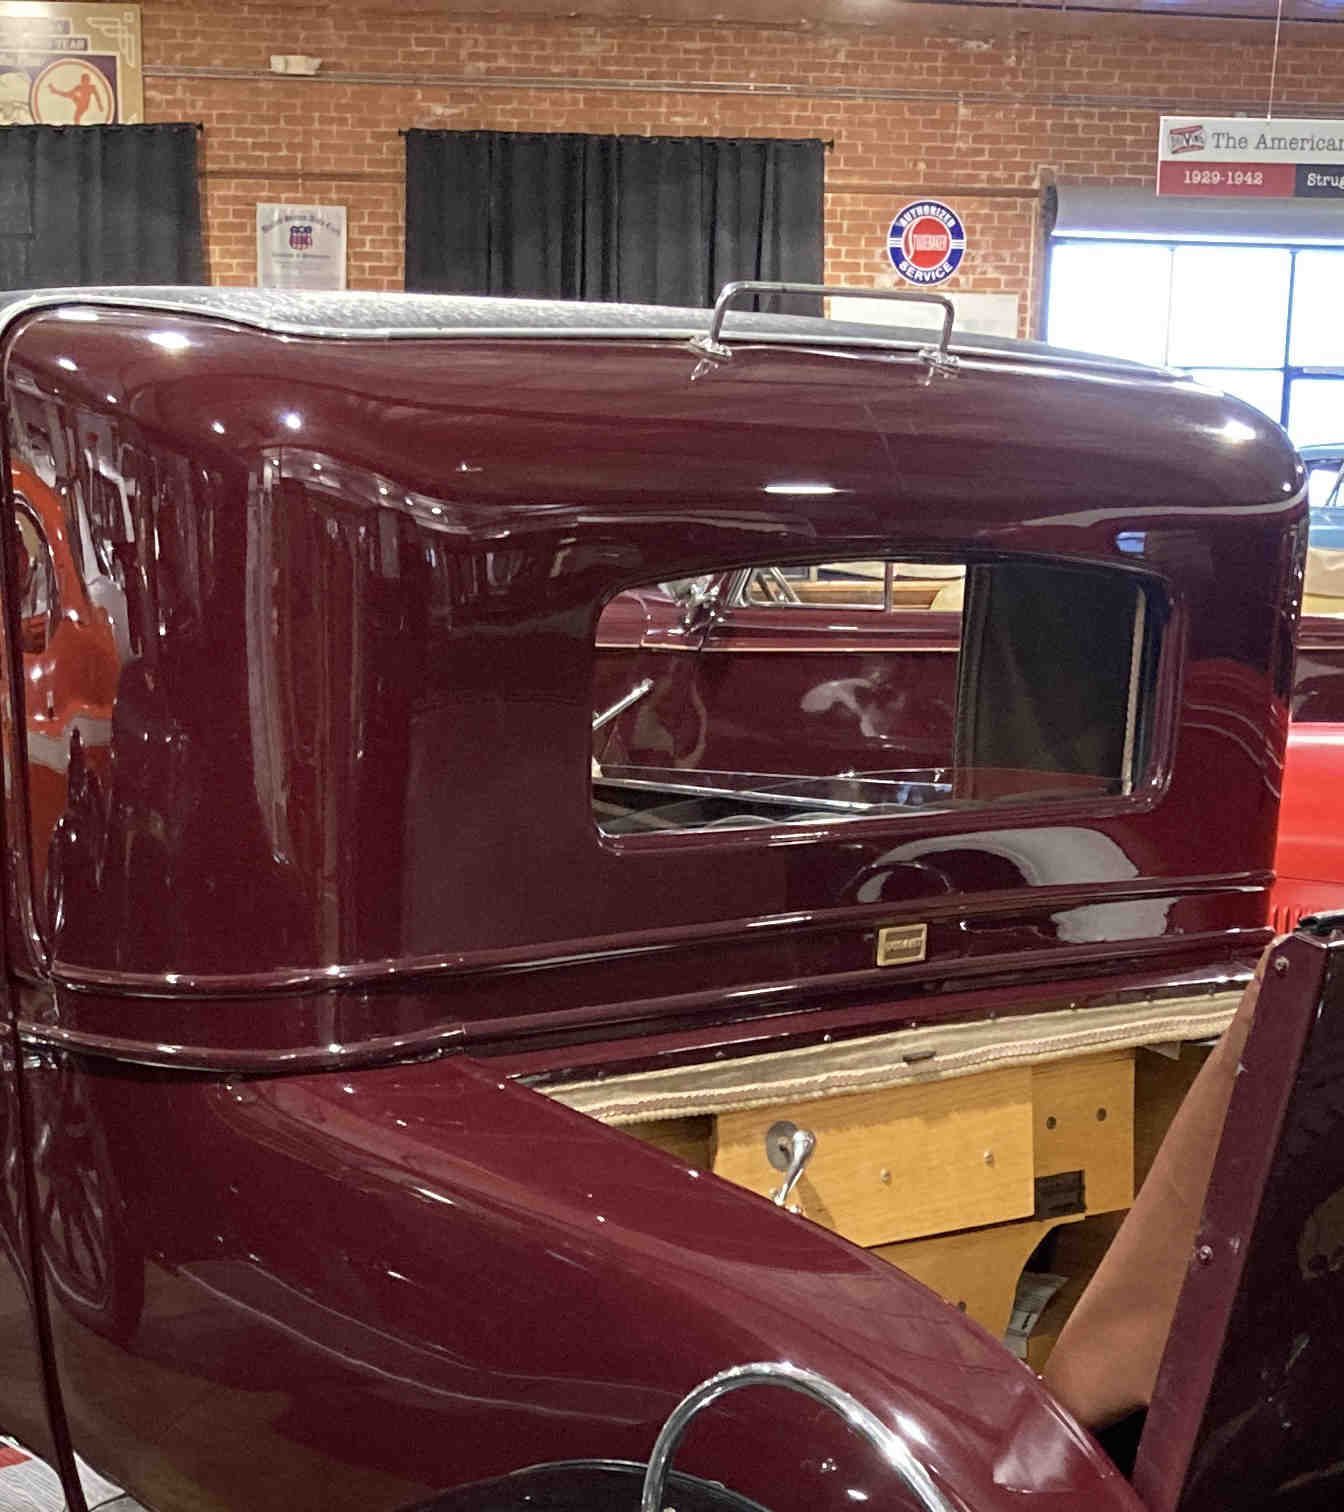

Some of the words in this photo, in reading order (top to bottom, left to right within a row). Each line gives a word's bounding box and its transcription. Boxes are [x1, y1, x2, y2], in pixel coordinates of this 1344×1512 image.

[1211, 131, 1249, 150] The
[1183, 170, 1264, 185] 1929-1942
[898, 205, 956, 228] AUTHORIZED
[898, 260, 954, 282] SERVICE
